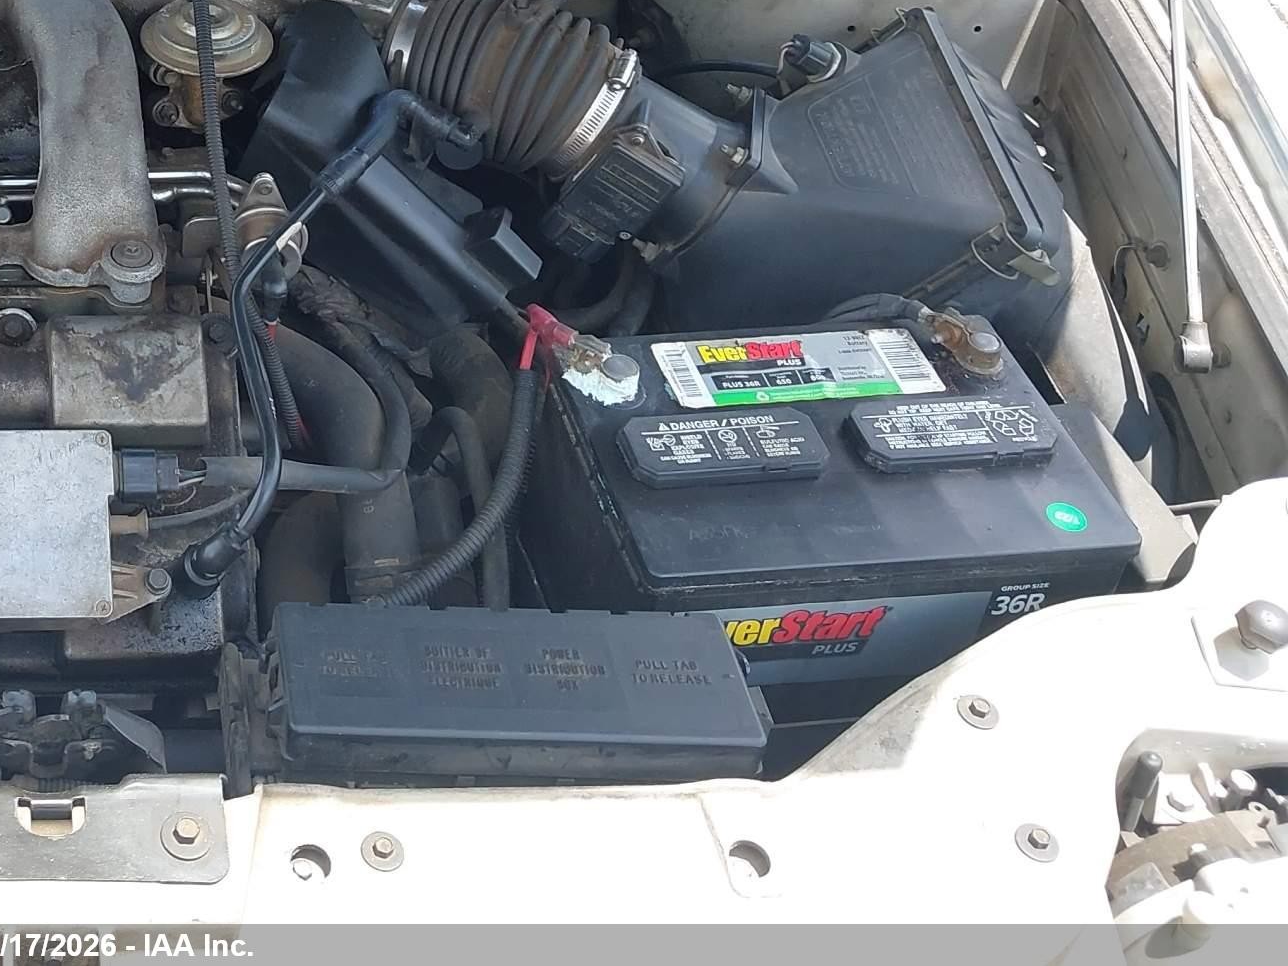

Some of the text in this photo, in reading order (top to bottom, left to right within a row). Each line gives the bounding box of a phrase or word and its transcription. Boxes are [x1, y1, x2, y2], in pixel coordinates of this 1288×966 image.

[696, 340, 803, 363] EverStart
[777, 358, 802, 367] PLUS
[722, 379, 762, 389] PLUS 36R
[669, 419, 720, 431] DANGER
[730, 415, 775, 426] POISON
[989, 593, 1045, 615] 36R
[726, 605, 889, 646] verStart
[541, 648, 580, 660] POWER
[813, 642, 858, 654] PLUS
[525, 662, 605, 675] DISTRIBUTION
[635, 659, 697, 670] PULL TAB
[632, 673, 712, 684] TO RELEASE
[557, 679, 579, 691] BOX
